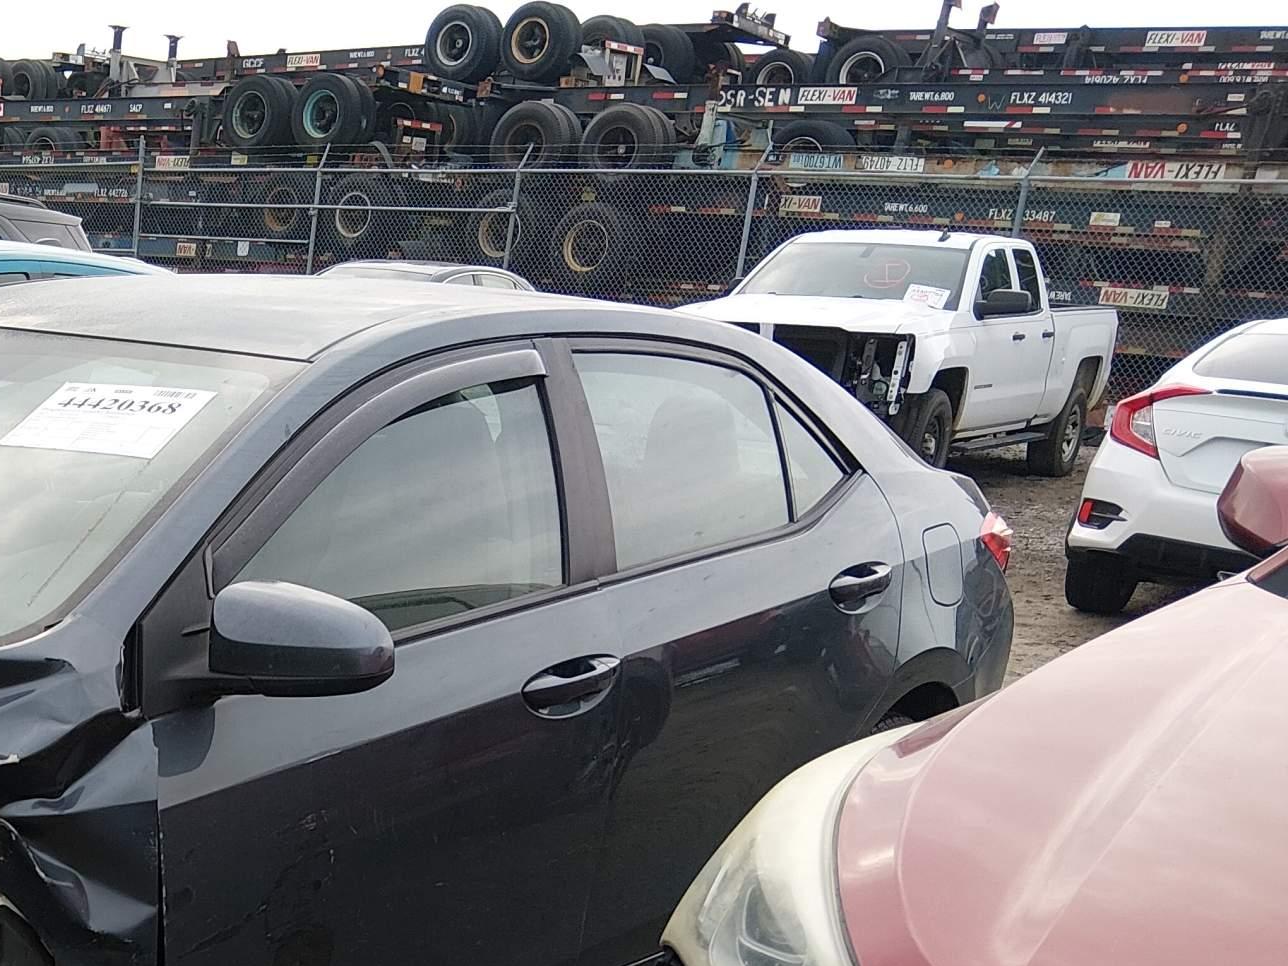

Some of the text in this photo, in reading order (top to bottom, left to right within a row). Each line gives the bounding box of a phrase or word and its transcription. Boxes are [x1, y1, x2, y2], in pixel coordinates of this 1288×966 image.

[1147, 32, 1205, 44] FLEXI-VAN
[799, 89, 856, 102] FLEXI-VAN
[1010, 92, 1072, 104] FLXZ 414321
[1129, 162, 1225, 180] FLEXI-VAN
[988, 208, 1057, 222] FLXZ 33487
[1101, 289, 1168, 307] FLEXI-VAN
[57, 397, 182, 415] 44420368
[1163, 428, 1203, 439] CIVIC
